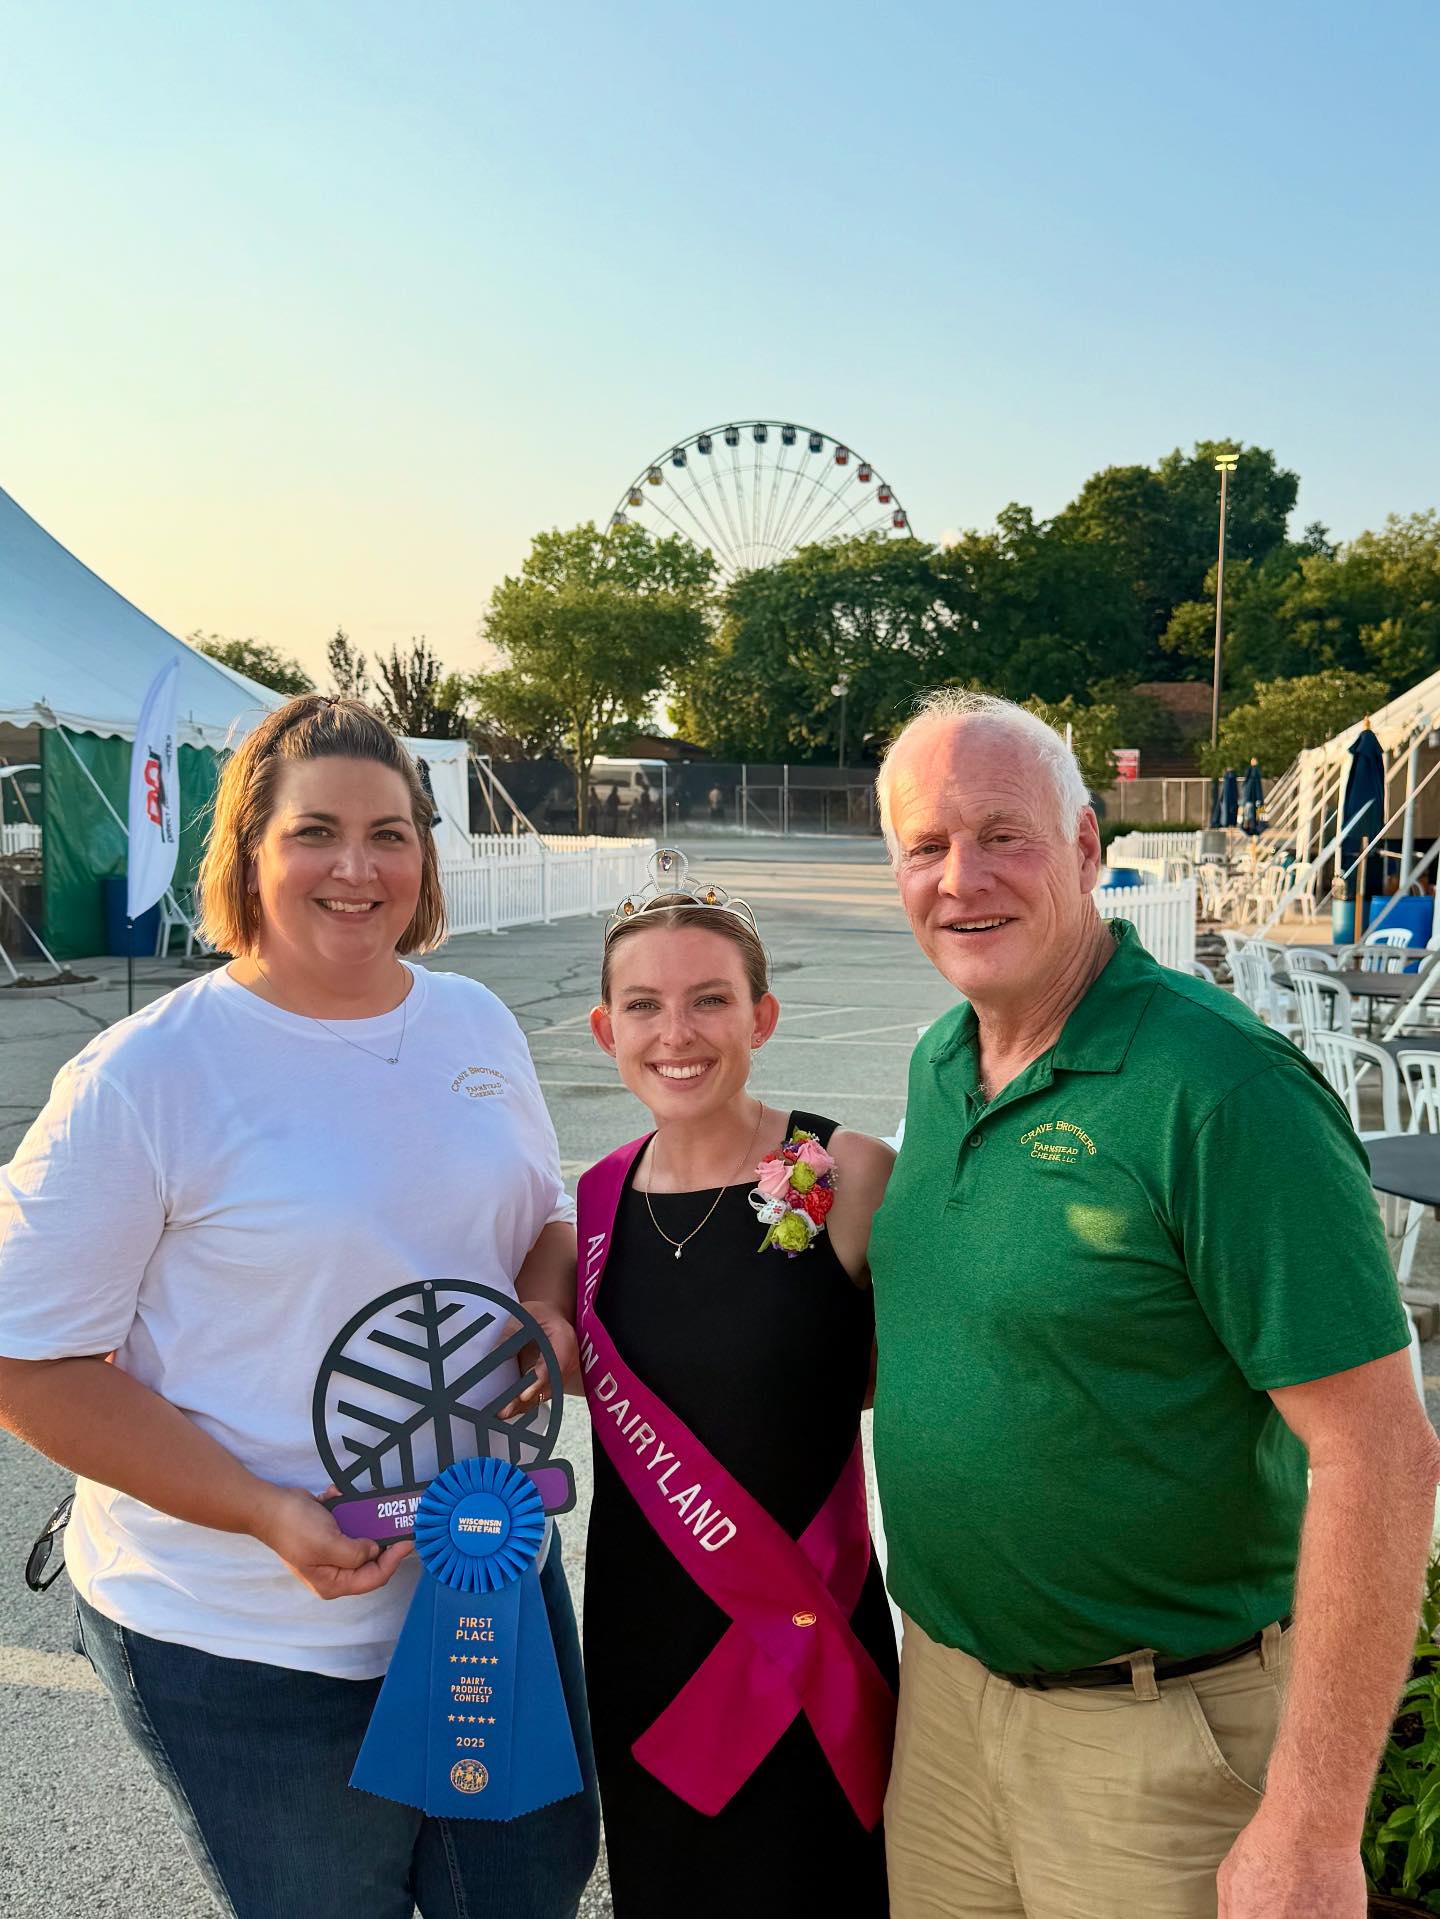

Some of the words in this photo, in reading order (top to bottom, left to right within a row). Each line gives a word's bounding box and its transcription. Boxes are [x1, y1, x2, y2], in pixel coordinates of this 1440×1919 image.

[1020, 1123, 1053, 1144] CRAVE
[1056, 1120, 1097, 1155] BROTHERS
[1033, 1142, 1078, 1155] FARMSTEAD
[1031, 1150, 1061, 1162] CHEESE
[581, 1332, 600, 1374] IN
[594, 1372, 737, 1552] DAIRYLAND
[377, 1500, 407, 1518] 2025
[459, 1517, 502, 1527] WISCONSIN
[458, 1524, 482, 1532] STATE
[483, 1526, 501, 1534] FAIR
[459, 1616, 493, 1629] FIRST
[456, 1630, 495, 1642] PLACE
[460, 1676, 486, 1686] DAIRY
[451, 1685, 493, 1695] PRODUCTS
[454, 1694, 490, 1703] CONTEST
[456, 1736, 485, 1748] 2025
